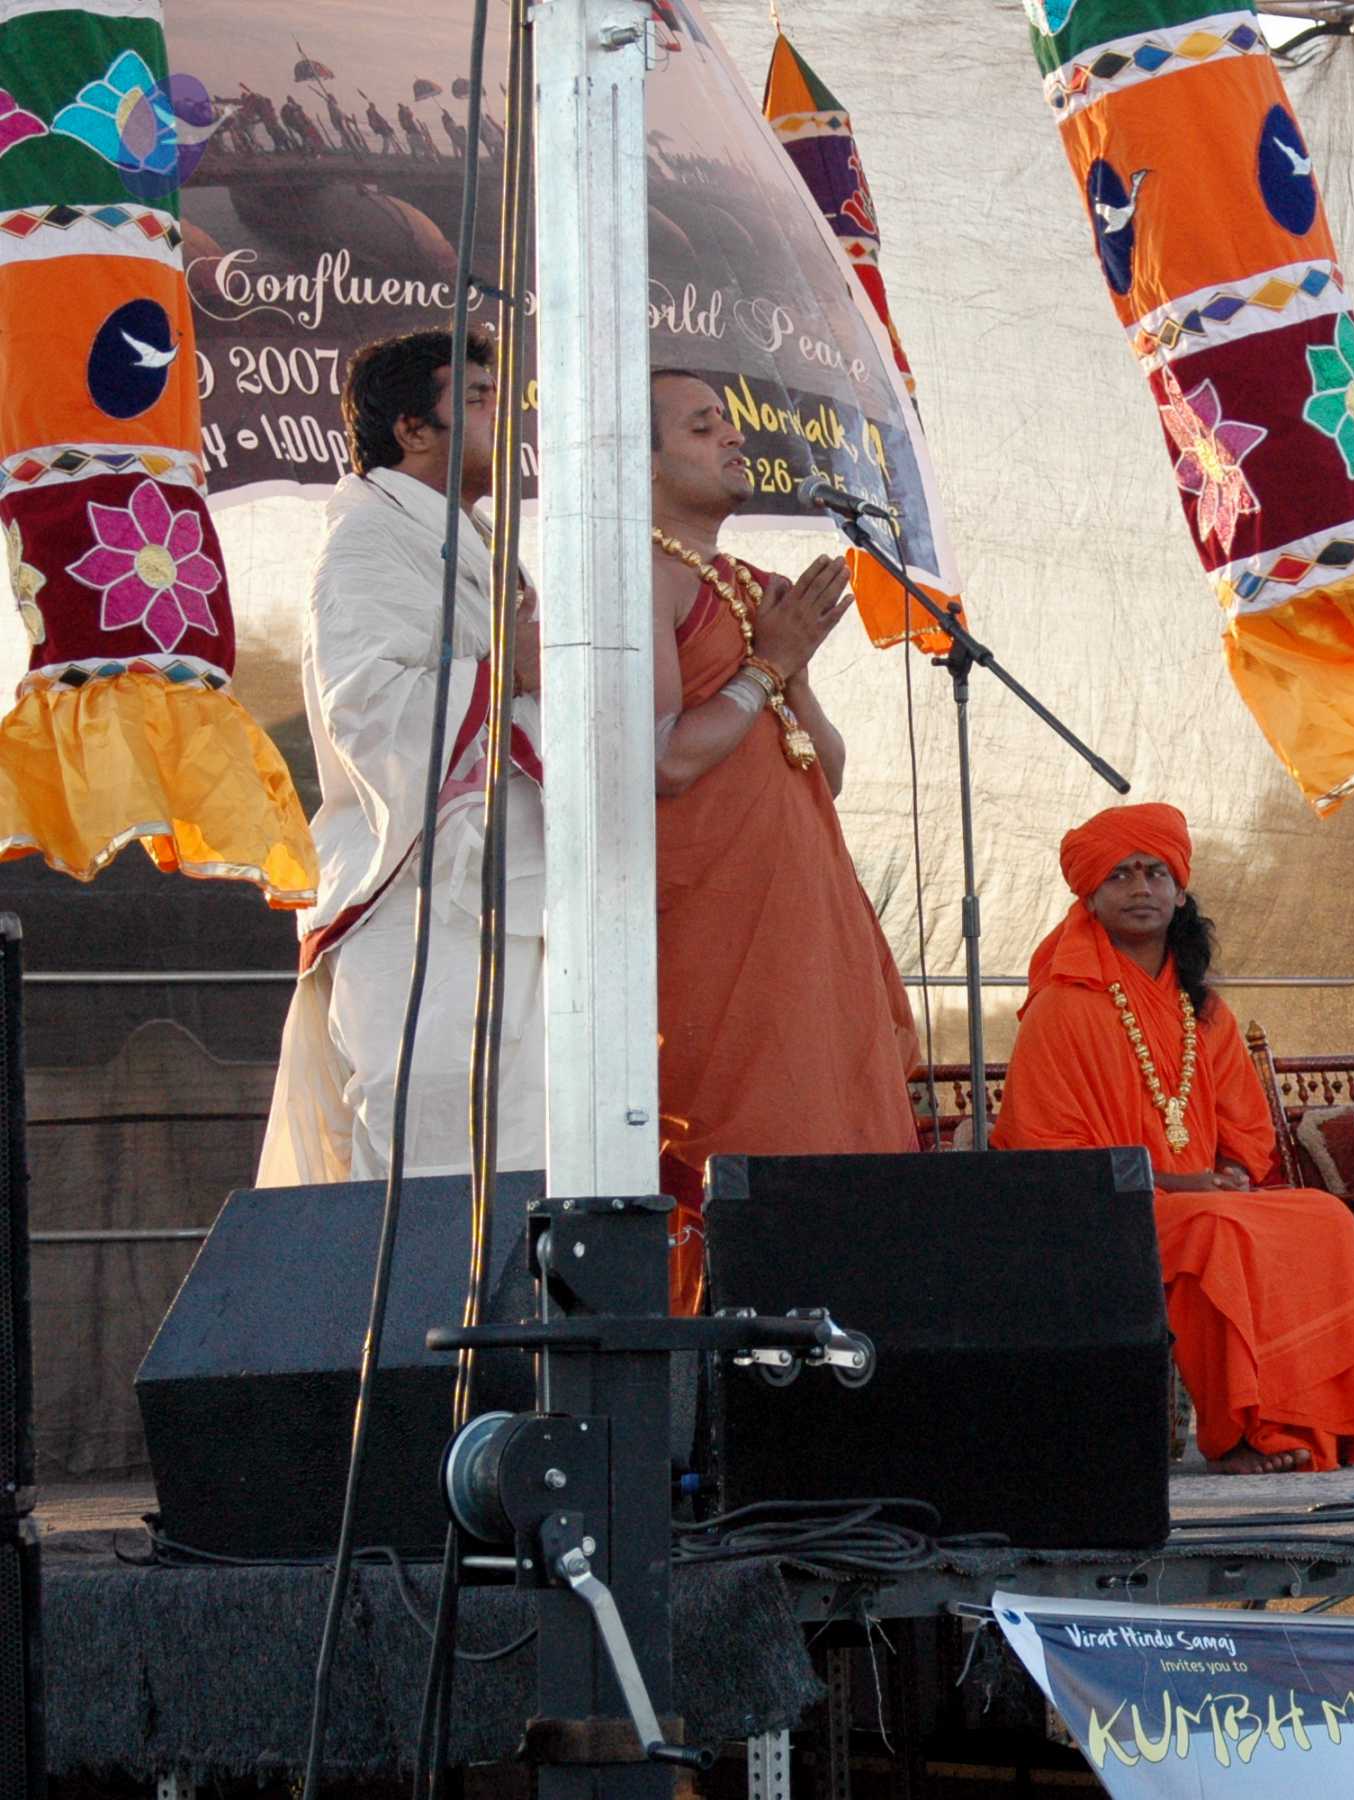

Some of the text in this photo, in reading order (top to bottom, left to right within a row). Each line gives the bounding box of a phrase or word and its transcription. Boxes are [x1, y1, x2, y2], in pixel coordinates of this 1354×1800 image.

[648, 279, 725, 339] orld
[229, 346, 341, 395] 2007
[1064, 1622, 1237, 1657] Virat Hindu Samaj
[1160, 1658, 1248, 1675] Invites you to
[1088, 1689, 1312, 1770] KUMBH
